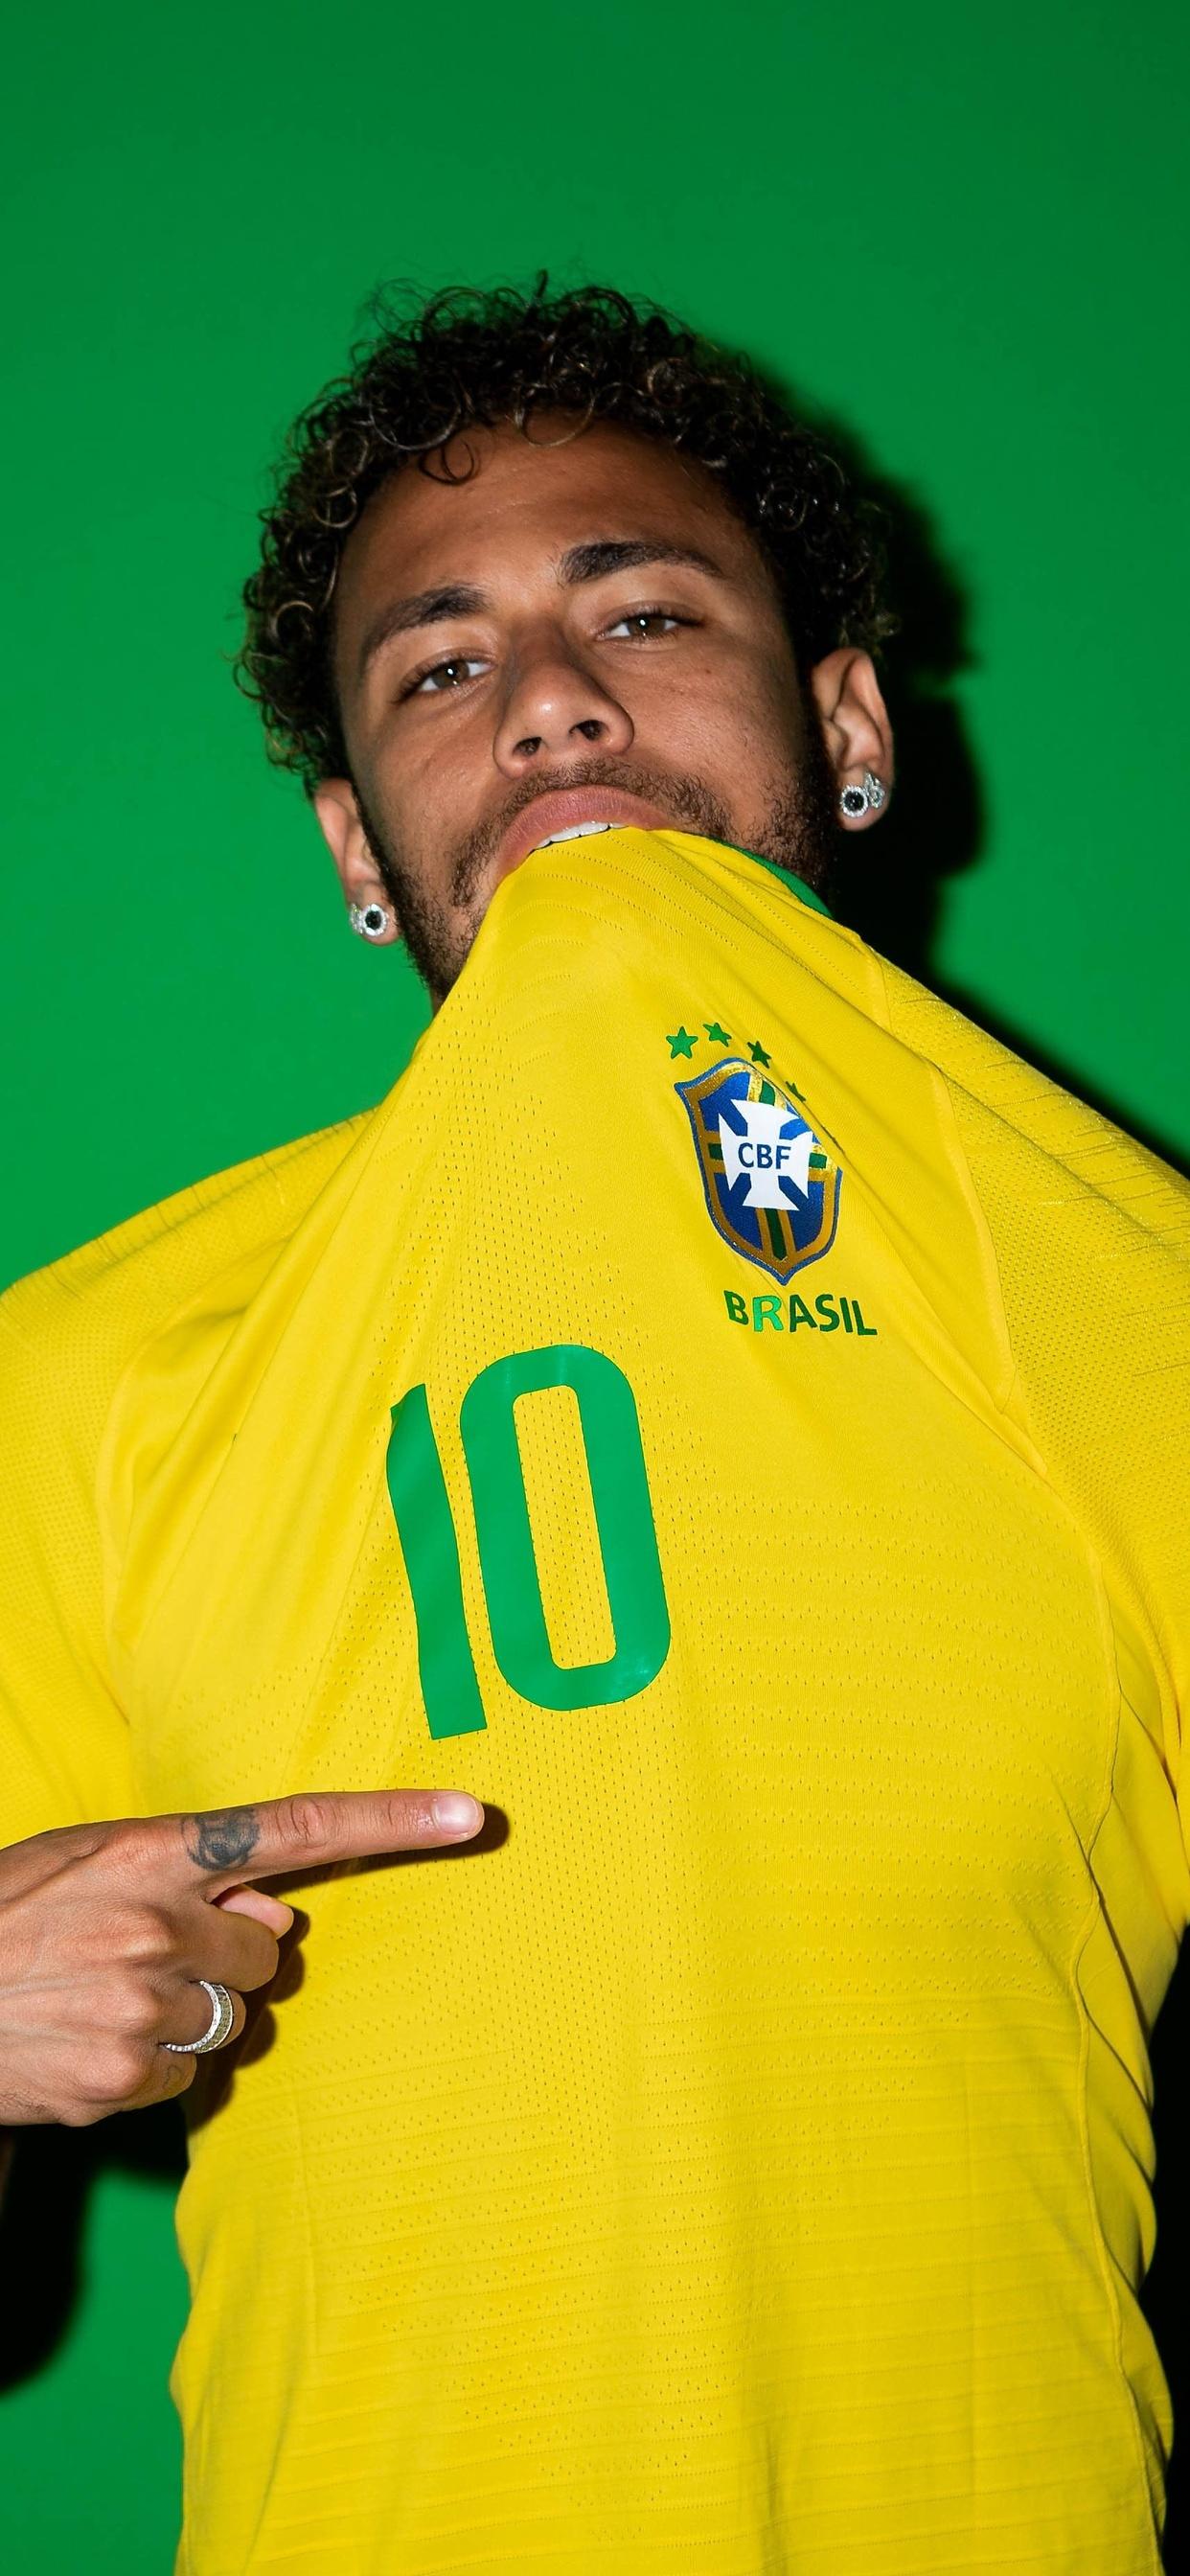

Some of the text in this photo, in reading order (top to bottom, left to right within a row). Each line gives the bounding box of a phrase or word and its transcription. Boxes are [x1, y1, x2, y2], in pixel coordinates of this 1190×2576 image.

[738, 1142, 791, 1170] CBF
[723, 1290, 878, 1336] BRASIL
[386, 1344, 671, 1740] 10
